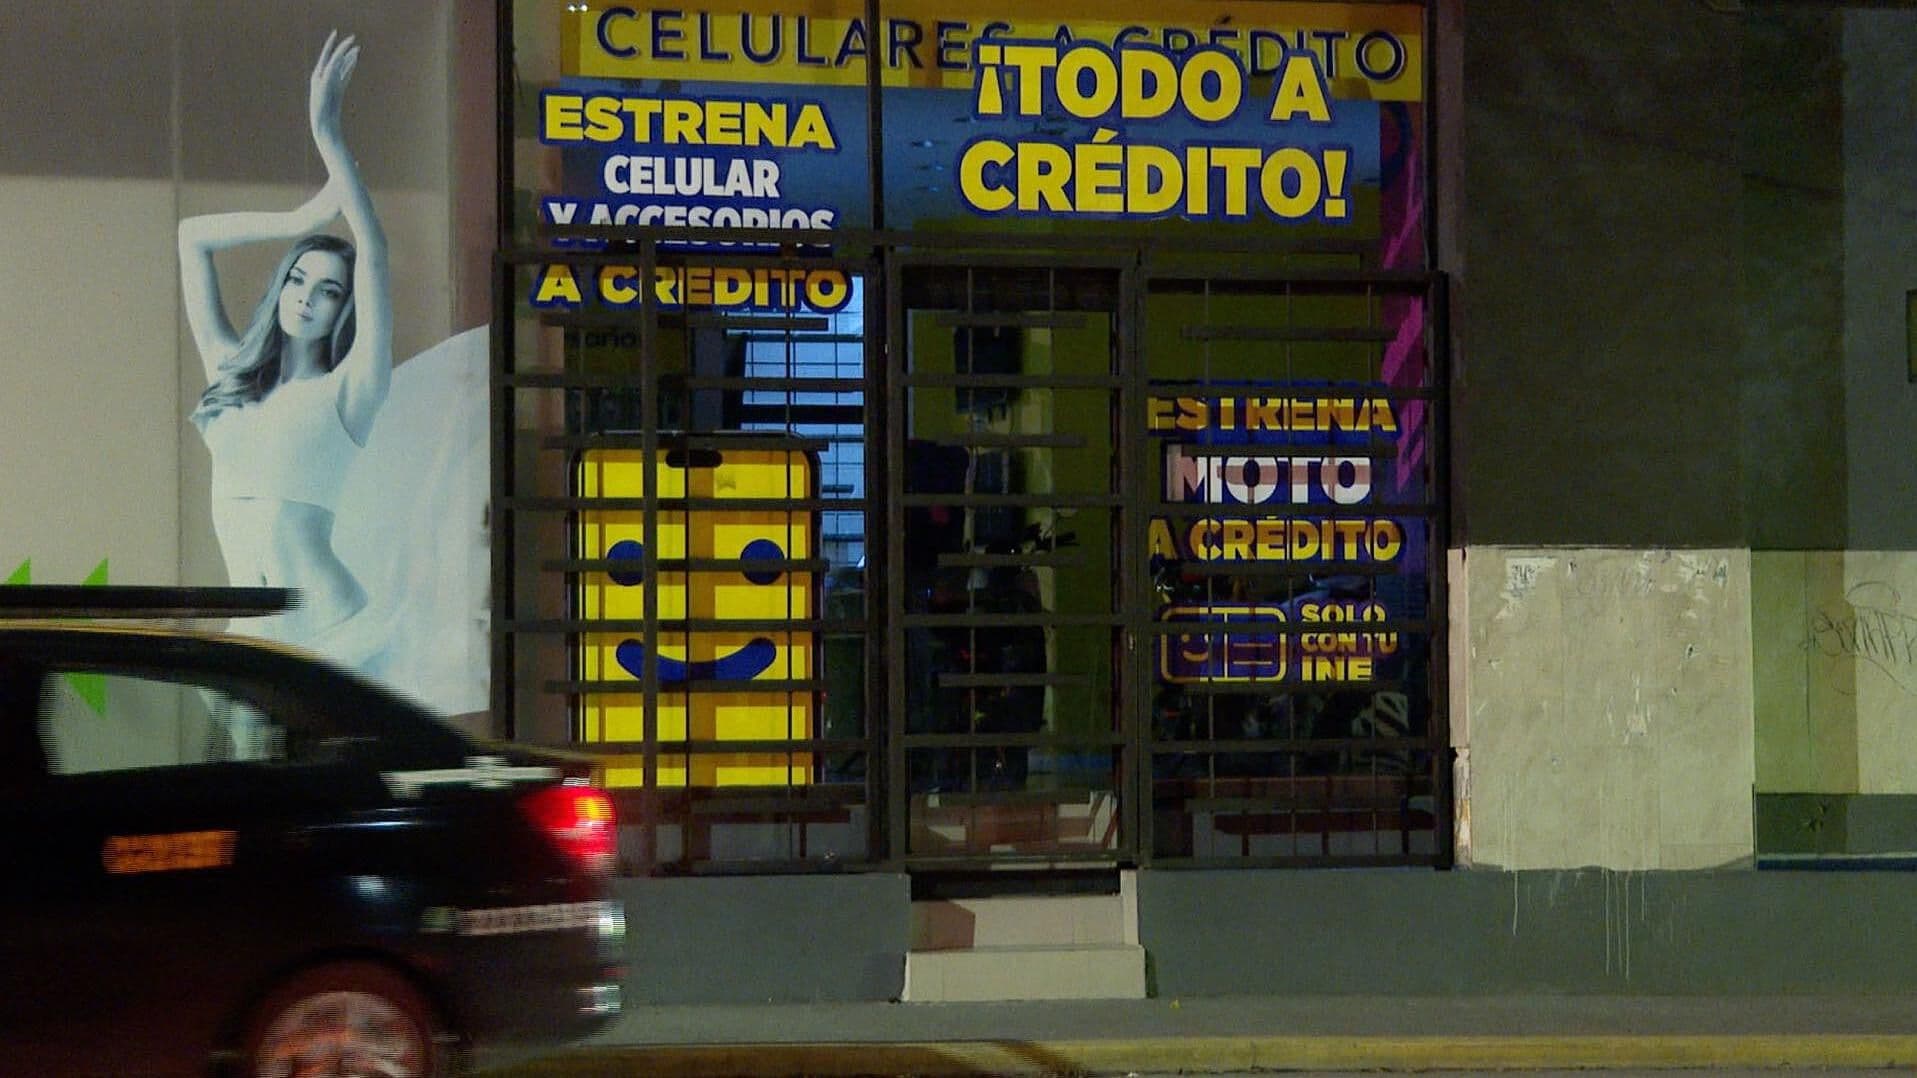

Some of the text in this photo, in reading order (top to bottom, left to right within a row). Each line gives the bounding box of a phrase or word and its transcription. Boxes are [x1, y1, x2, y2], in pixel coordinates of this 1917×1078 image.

[977, 44, 1331, 122] ¡TODO A
[545, 95, 836, 149] ESTRENA
[604, 155, 780, 199] CELULAR
[959, 127, 1348, 219] CRÉDITO!
[549, 202, 836, 248] Y ACCESORIOS
[535, 263, 583, 303] A
[1147, 396, 1398, 431] ESTRENA
[1165, 444, 1372, 504] MOTO
[1148, 517, 1178, 561] A
[1301, 603, 1386, 624] SOLO
[1301, 632, 1398, 653] CON TU
[1301, 656, 1373, 682] INE
